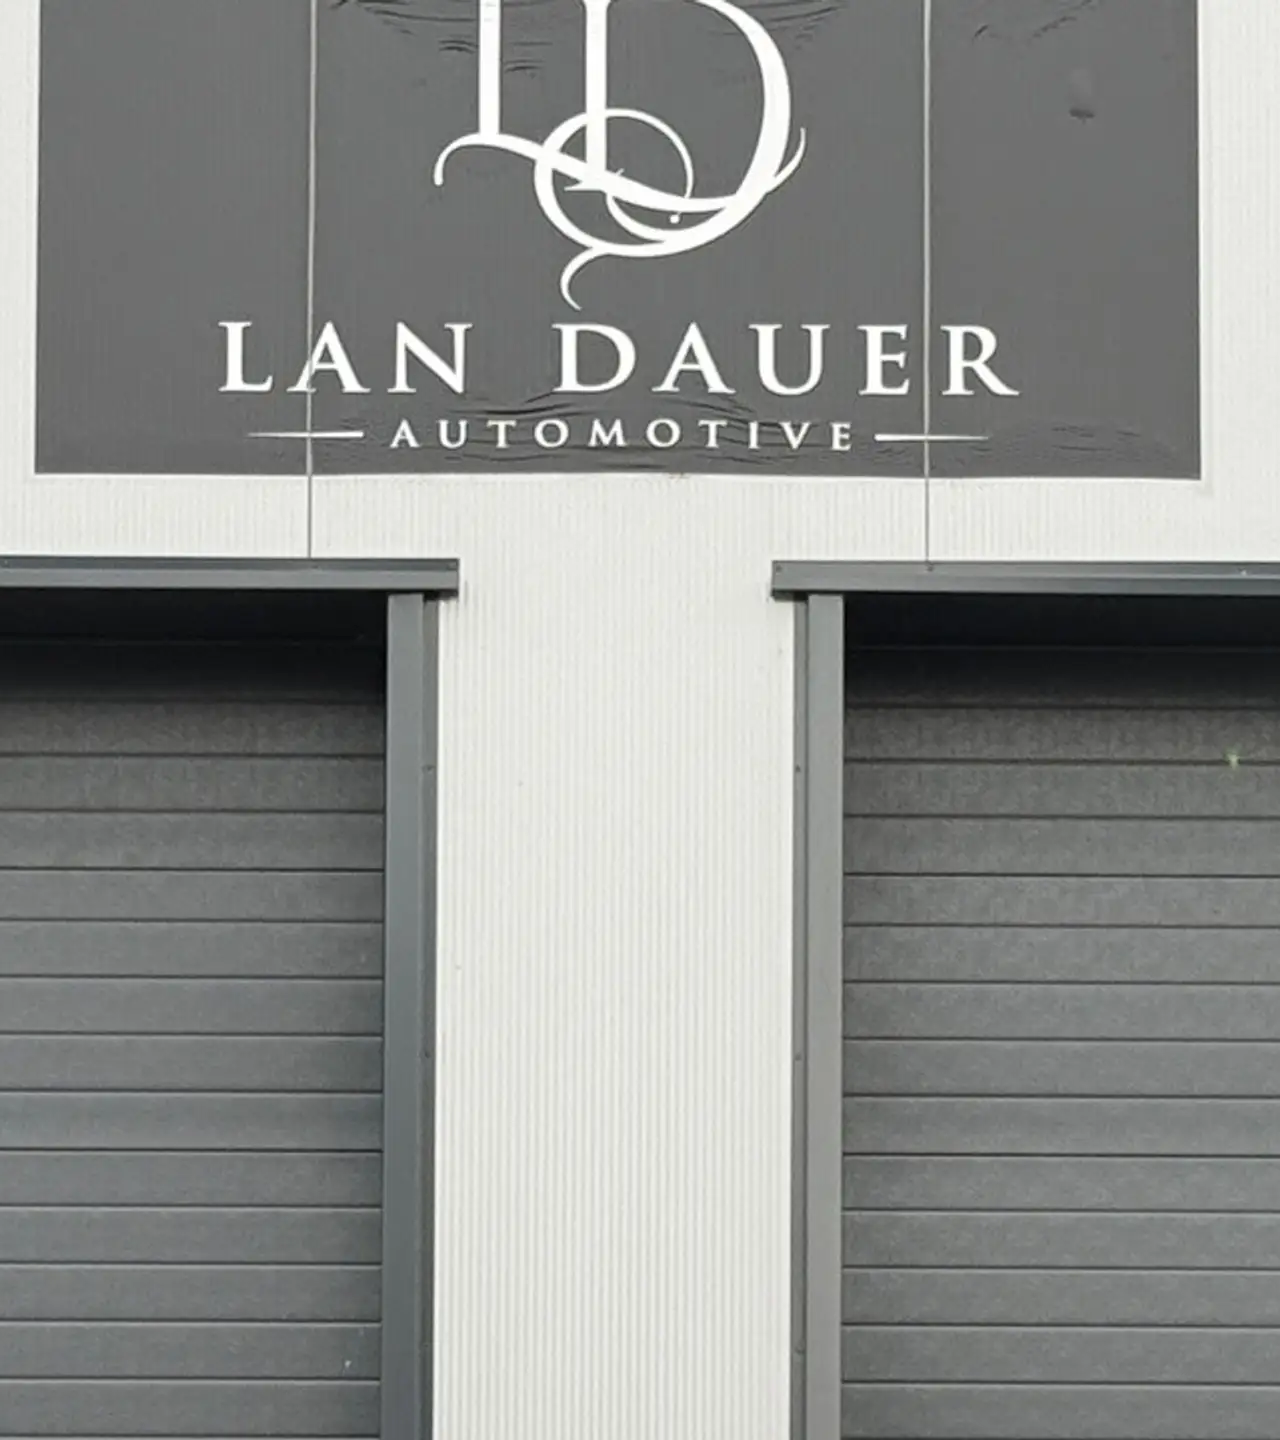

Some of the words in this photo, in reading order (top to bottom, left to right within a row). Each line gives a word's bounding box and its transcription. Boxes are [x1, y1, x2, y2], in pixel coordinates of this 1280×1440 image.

[217, 320, 474, 394] LAN
[552, 320, 1020, 397] DAUER
[390, 418, 853, 452] AUTOMOTIVE
